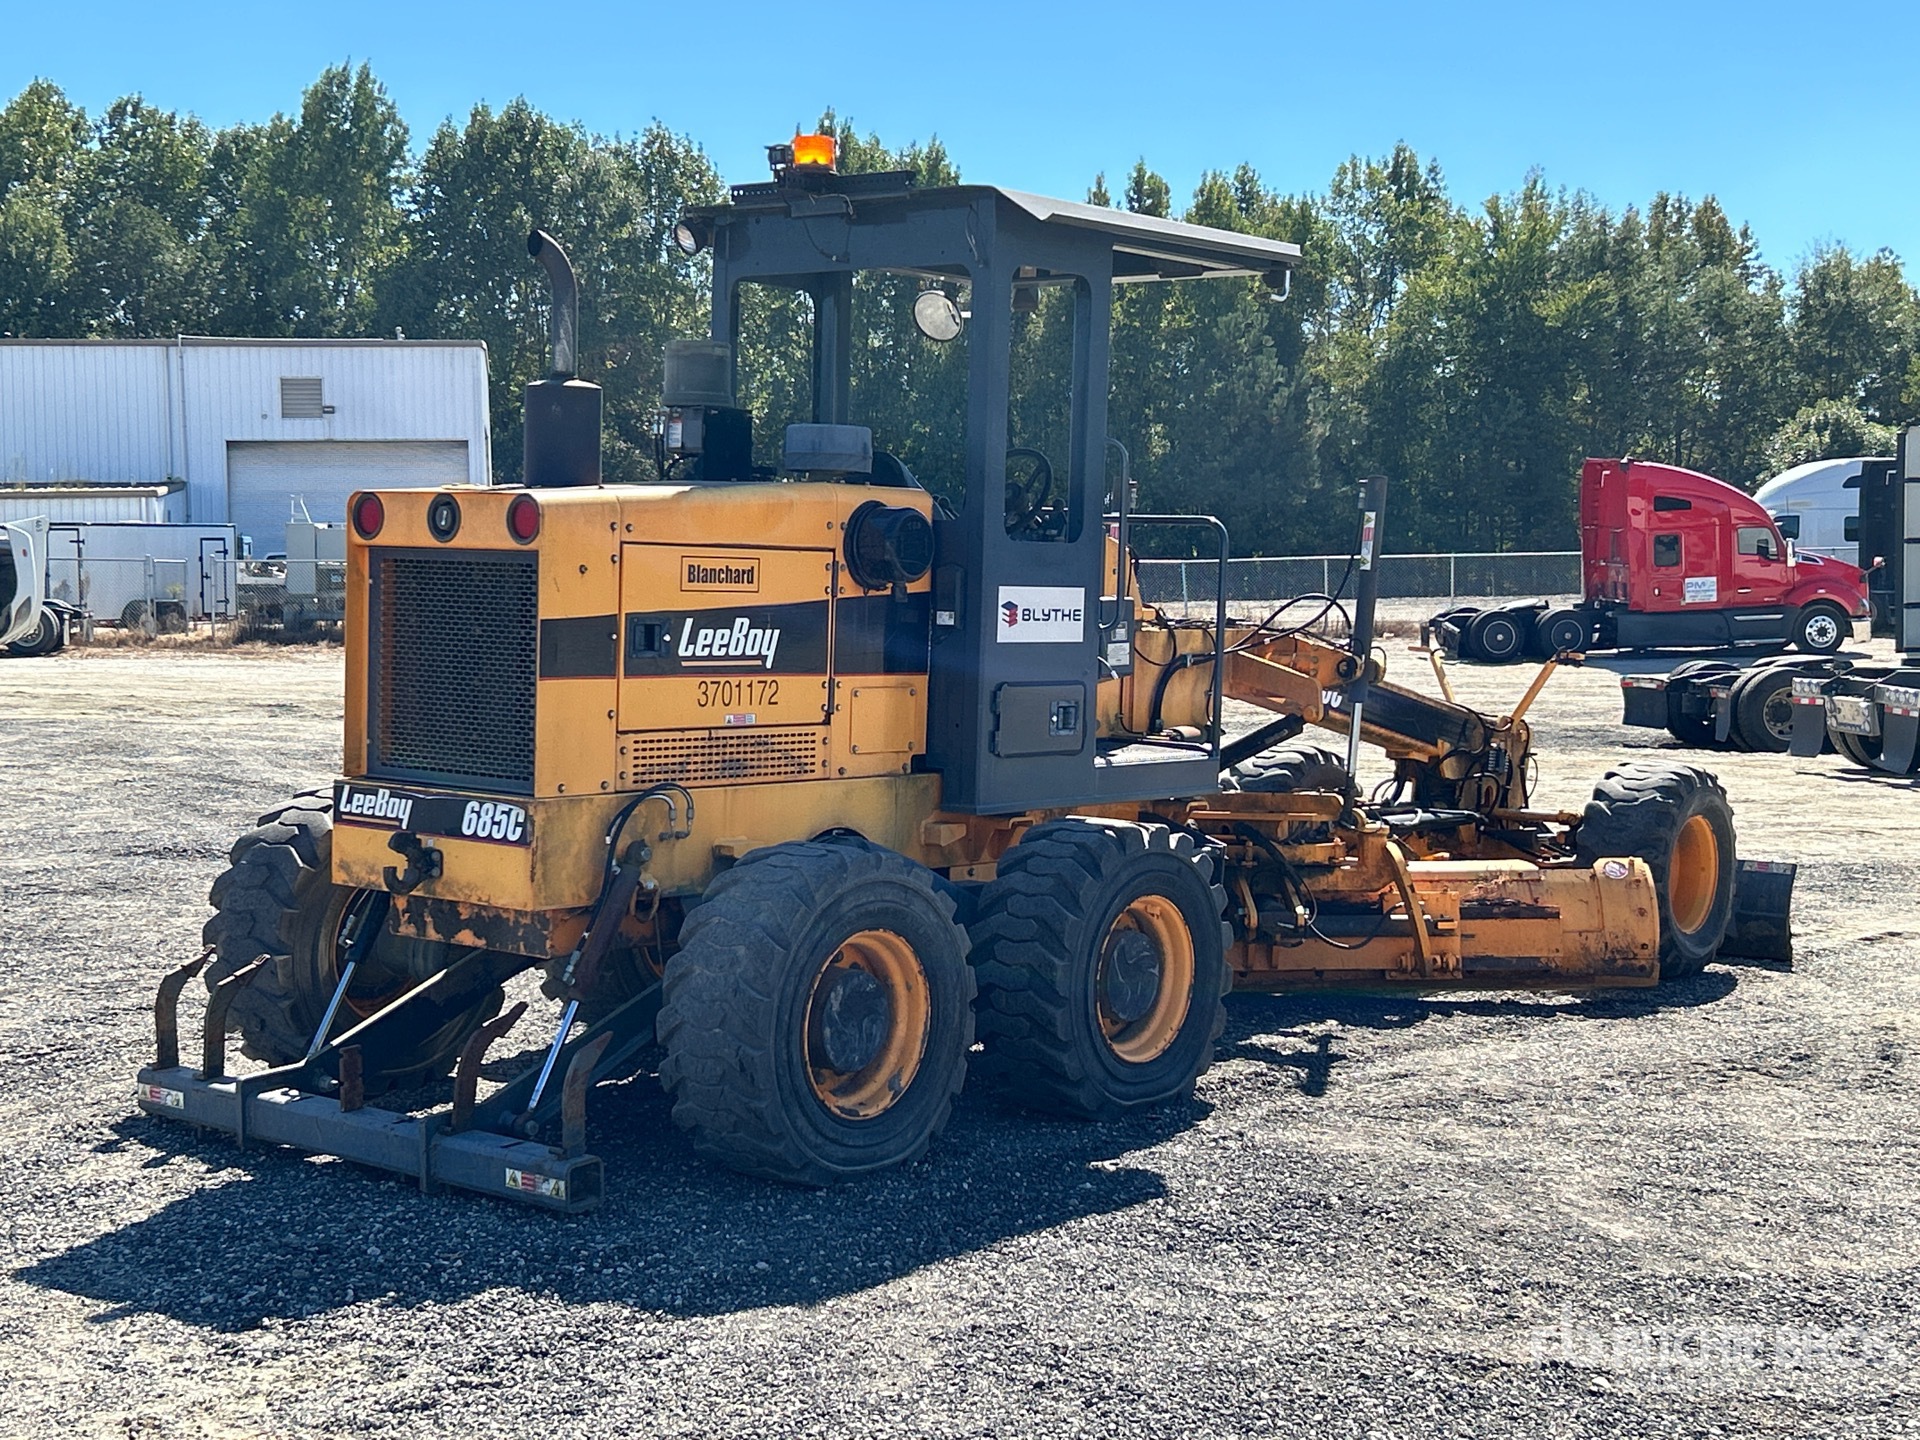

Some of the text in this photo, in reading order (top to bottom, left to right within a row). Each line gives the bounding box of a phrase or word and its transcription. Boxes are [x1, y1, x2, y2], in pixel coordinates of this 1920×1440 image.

[687, 564, 755, 585] Blanchard
[1021, 608, 1082, 622] BLYTHE
[677, 617, 781, 669] LeeBoy
[697, 679, 780, 707] 3701172
[338, 784, 413, 830] LeeBoy
[461, 800, 526, 842] 685C
